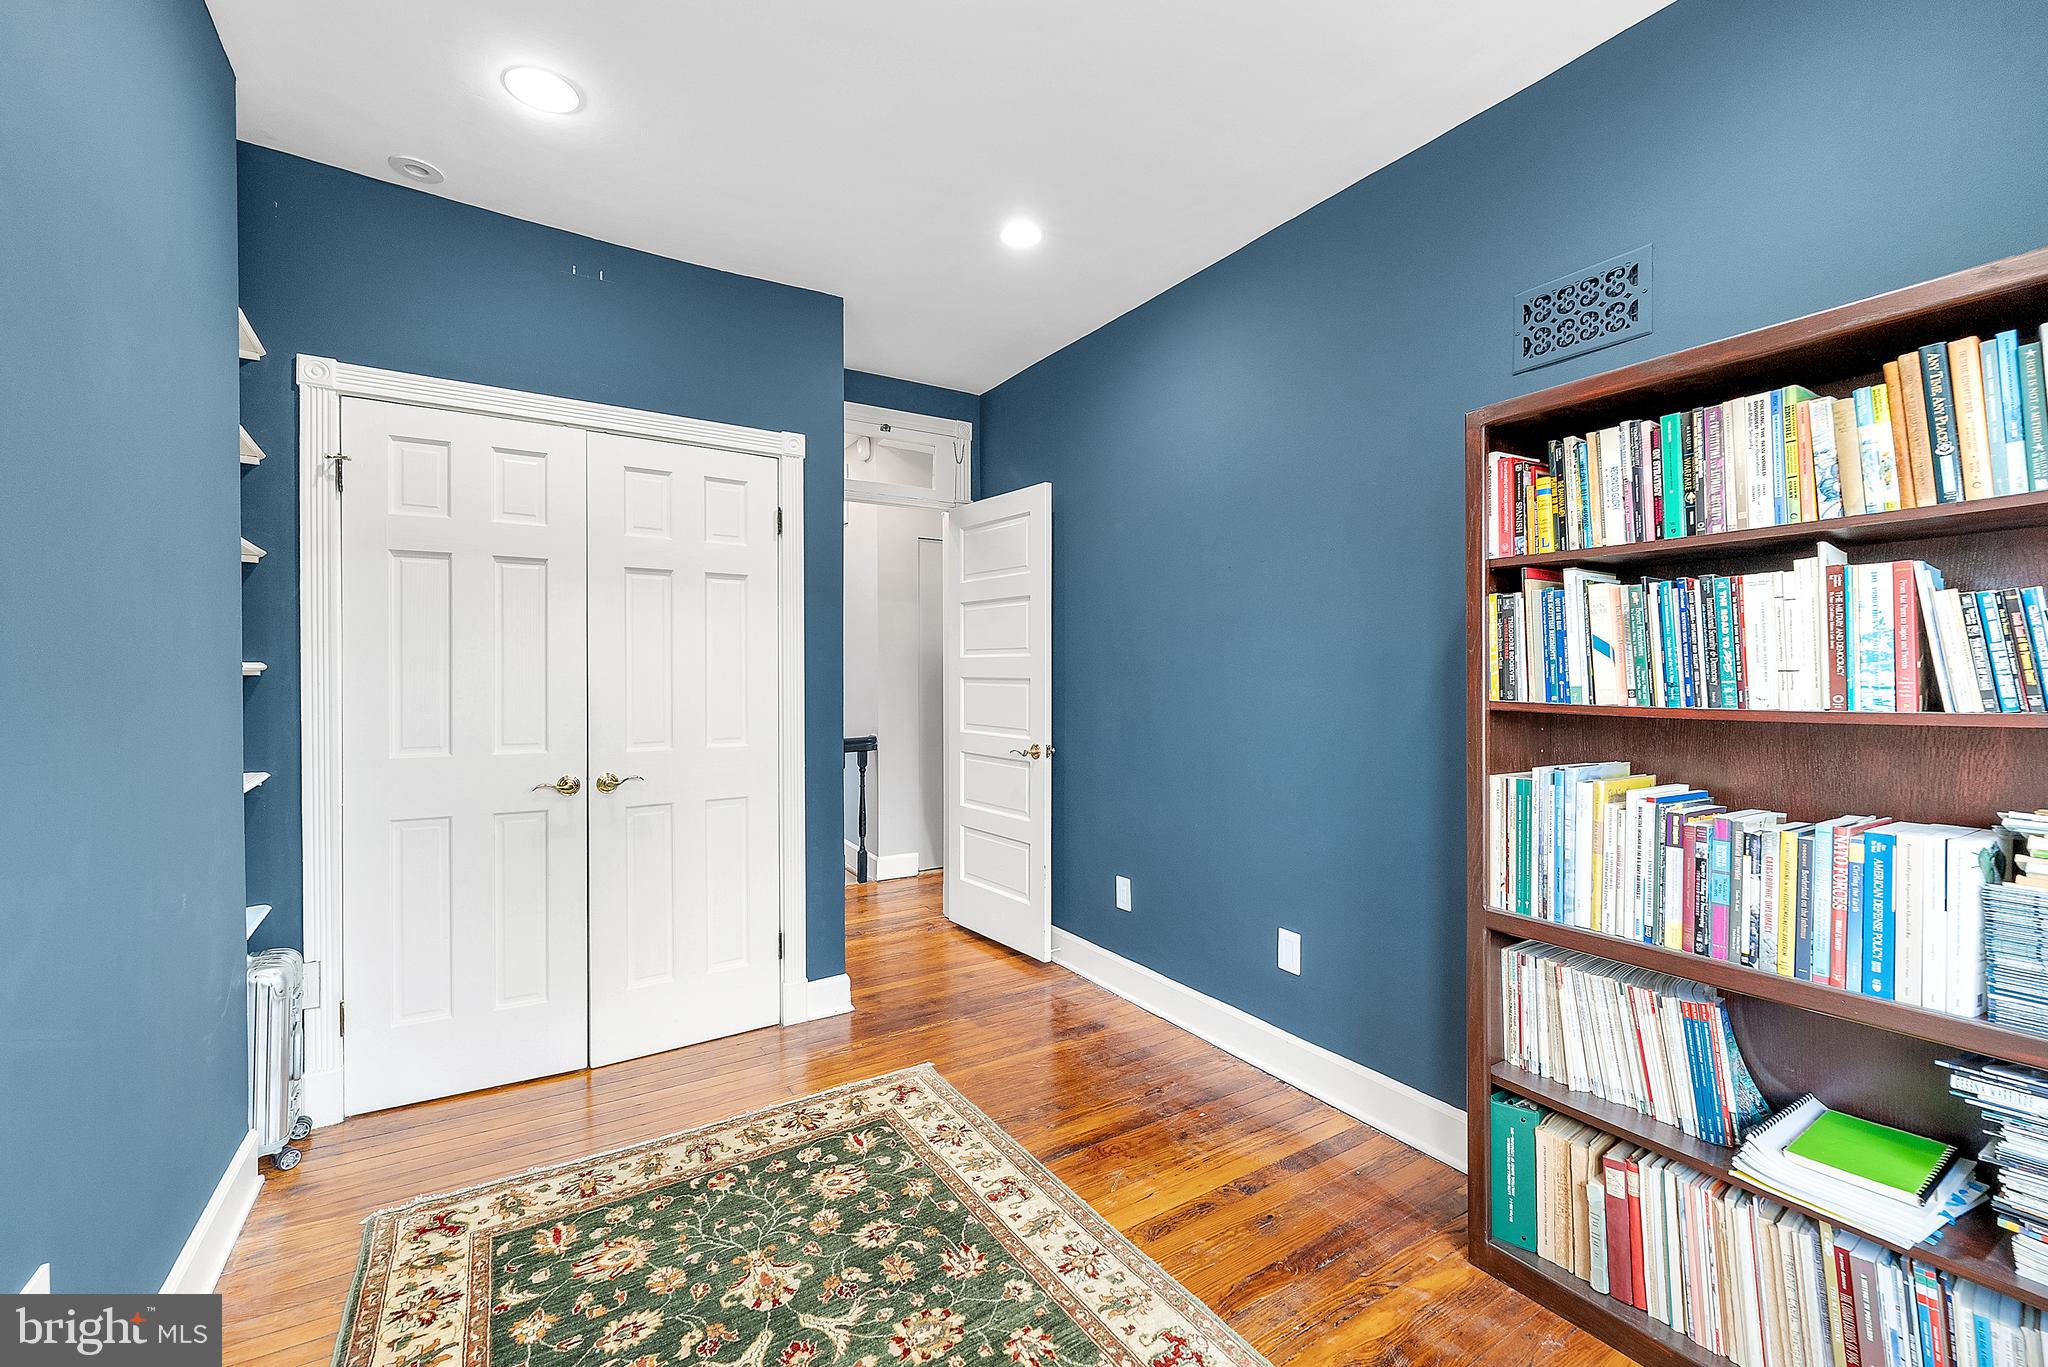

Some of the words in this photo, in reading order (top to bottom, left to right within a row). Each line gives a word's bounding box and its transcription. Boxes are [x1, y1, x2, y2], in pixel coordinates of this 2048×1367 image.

[1927, 353, 1941, 371] ANY
[1932, 397, 1945, 414] ANY
[2028, 387, 2039, 403] NOT
[1935, 415, 1948, 443] PLACE
[2031, 412, 2043, 442] METHOD
[1652, 449, 1661, 460] ON
[1653, 461, 1662, 497] STRATEGY
[1684, 457, 1692, 491] WARFARE
[1835, 591, 1843, 603] THE
[1900, 580, 1908, 593] From
[1720, 591, 1728, 607] THE
[1706, 598, 1716, 629] International
[1721, 609, 1730, 634] ROAD
[1706, 630, 1717, 650] Security
[1723, 636, 1730, 648] TO
[1836, 628, 1844, 641] AND
[1899, 625, 1909, 640] Eagles
[1901, 641, 1909, 650] and
[1709, 657, 1719, 686] Democracy
[1834, 834, 1848, 865] NATO
[1765, 856, 1773, 899] CATASTROPHIC
[1801, 869, 1809, 899] Borderland
[1851, 865, 1860, 886] Circling
[1873, 858, 1883, 898] AMERICAN
[1832, 867, 1848, 910] FORCES
[1852, 887, 1861, 896] the
[1801, 908, 1809, 917] the
[1852, 898, 1860, 912] Earth
[1872, 899, 1883, 932] DEFENSE
[1764, 900, 1773, 933] DIPLOMACY
[1872, 933, 1883, 961] POLICY
[1840, 1293, 1852, 1302] THE
[1861, 1279, 1870, 1302] HISTORY
[1840, 1303, 1854, 1321] CUBAN
[1843, 1321, 1857, 1342] EXODUS
[1864, 1310, 1874, 1342] POSTCARDS
